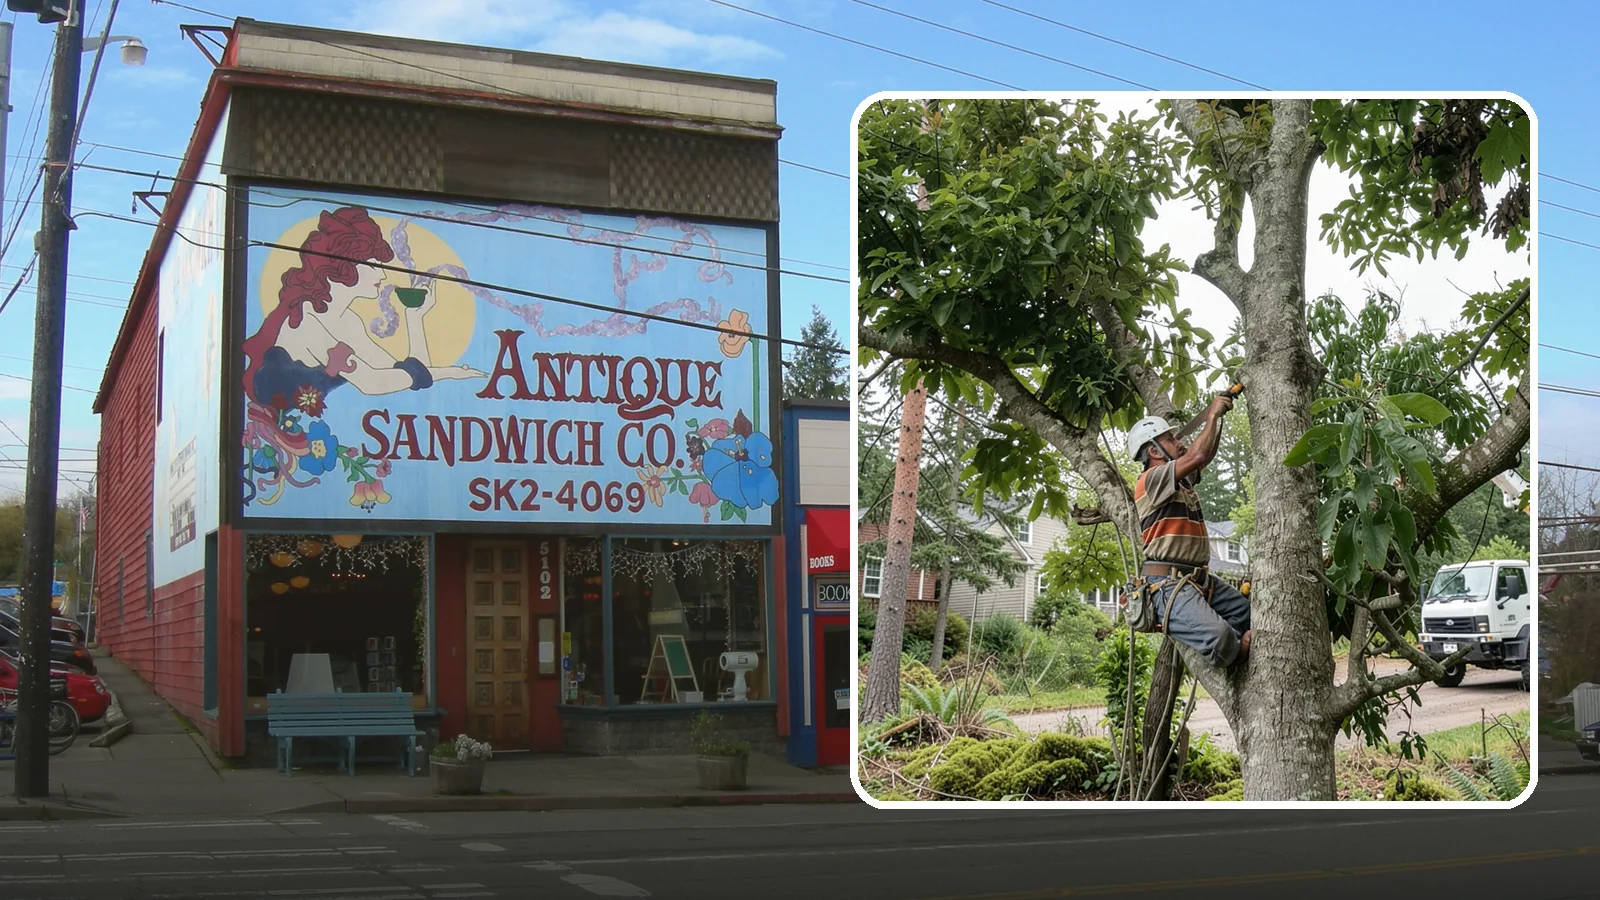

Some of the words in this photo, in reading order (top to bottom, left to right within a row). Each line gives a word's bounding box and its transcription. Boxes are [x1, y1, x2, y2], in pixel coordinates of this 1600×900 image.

[476, 329, 723, 420] ANTIQUE
[361, 409, 605, 467] SANDWICH
[617, 422, 685, 469] CO.
[468, 477, 646, 513] SK2-4069
[540, 541, 551, 599] 5102
[809, 555, 835, 568] BOOKS
